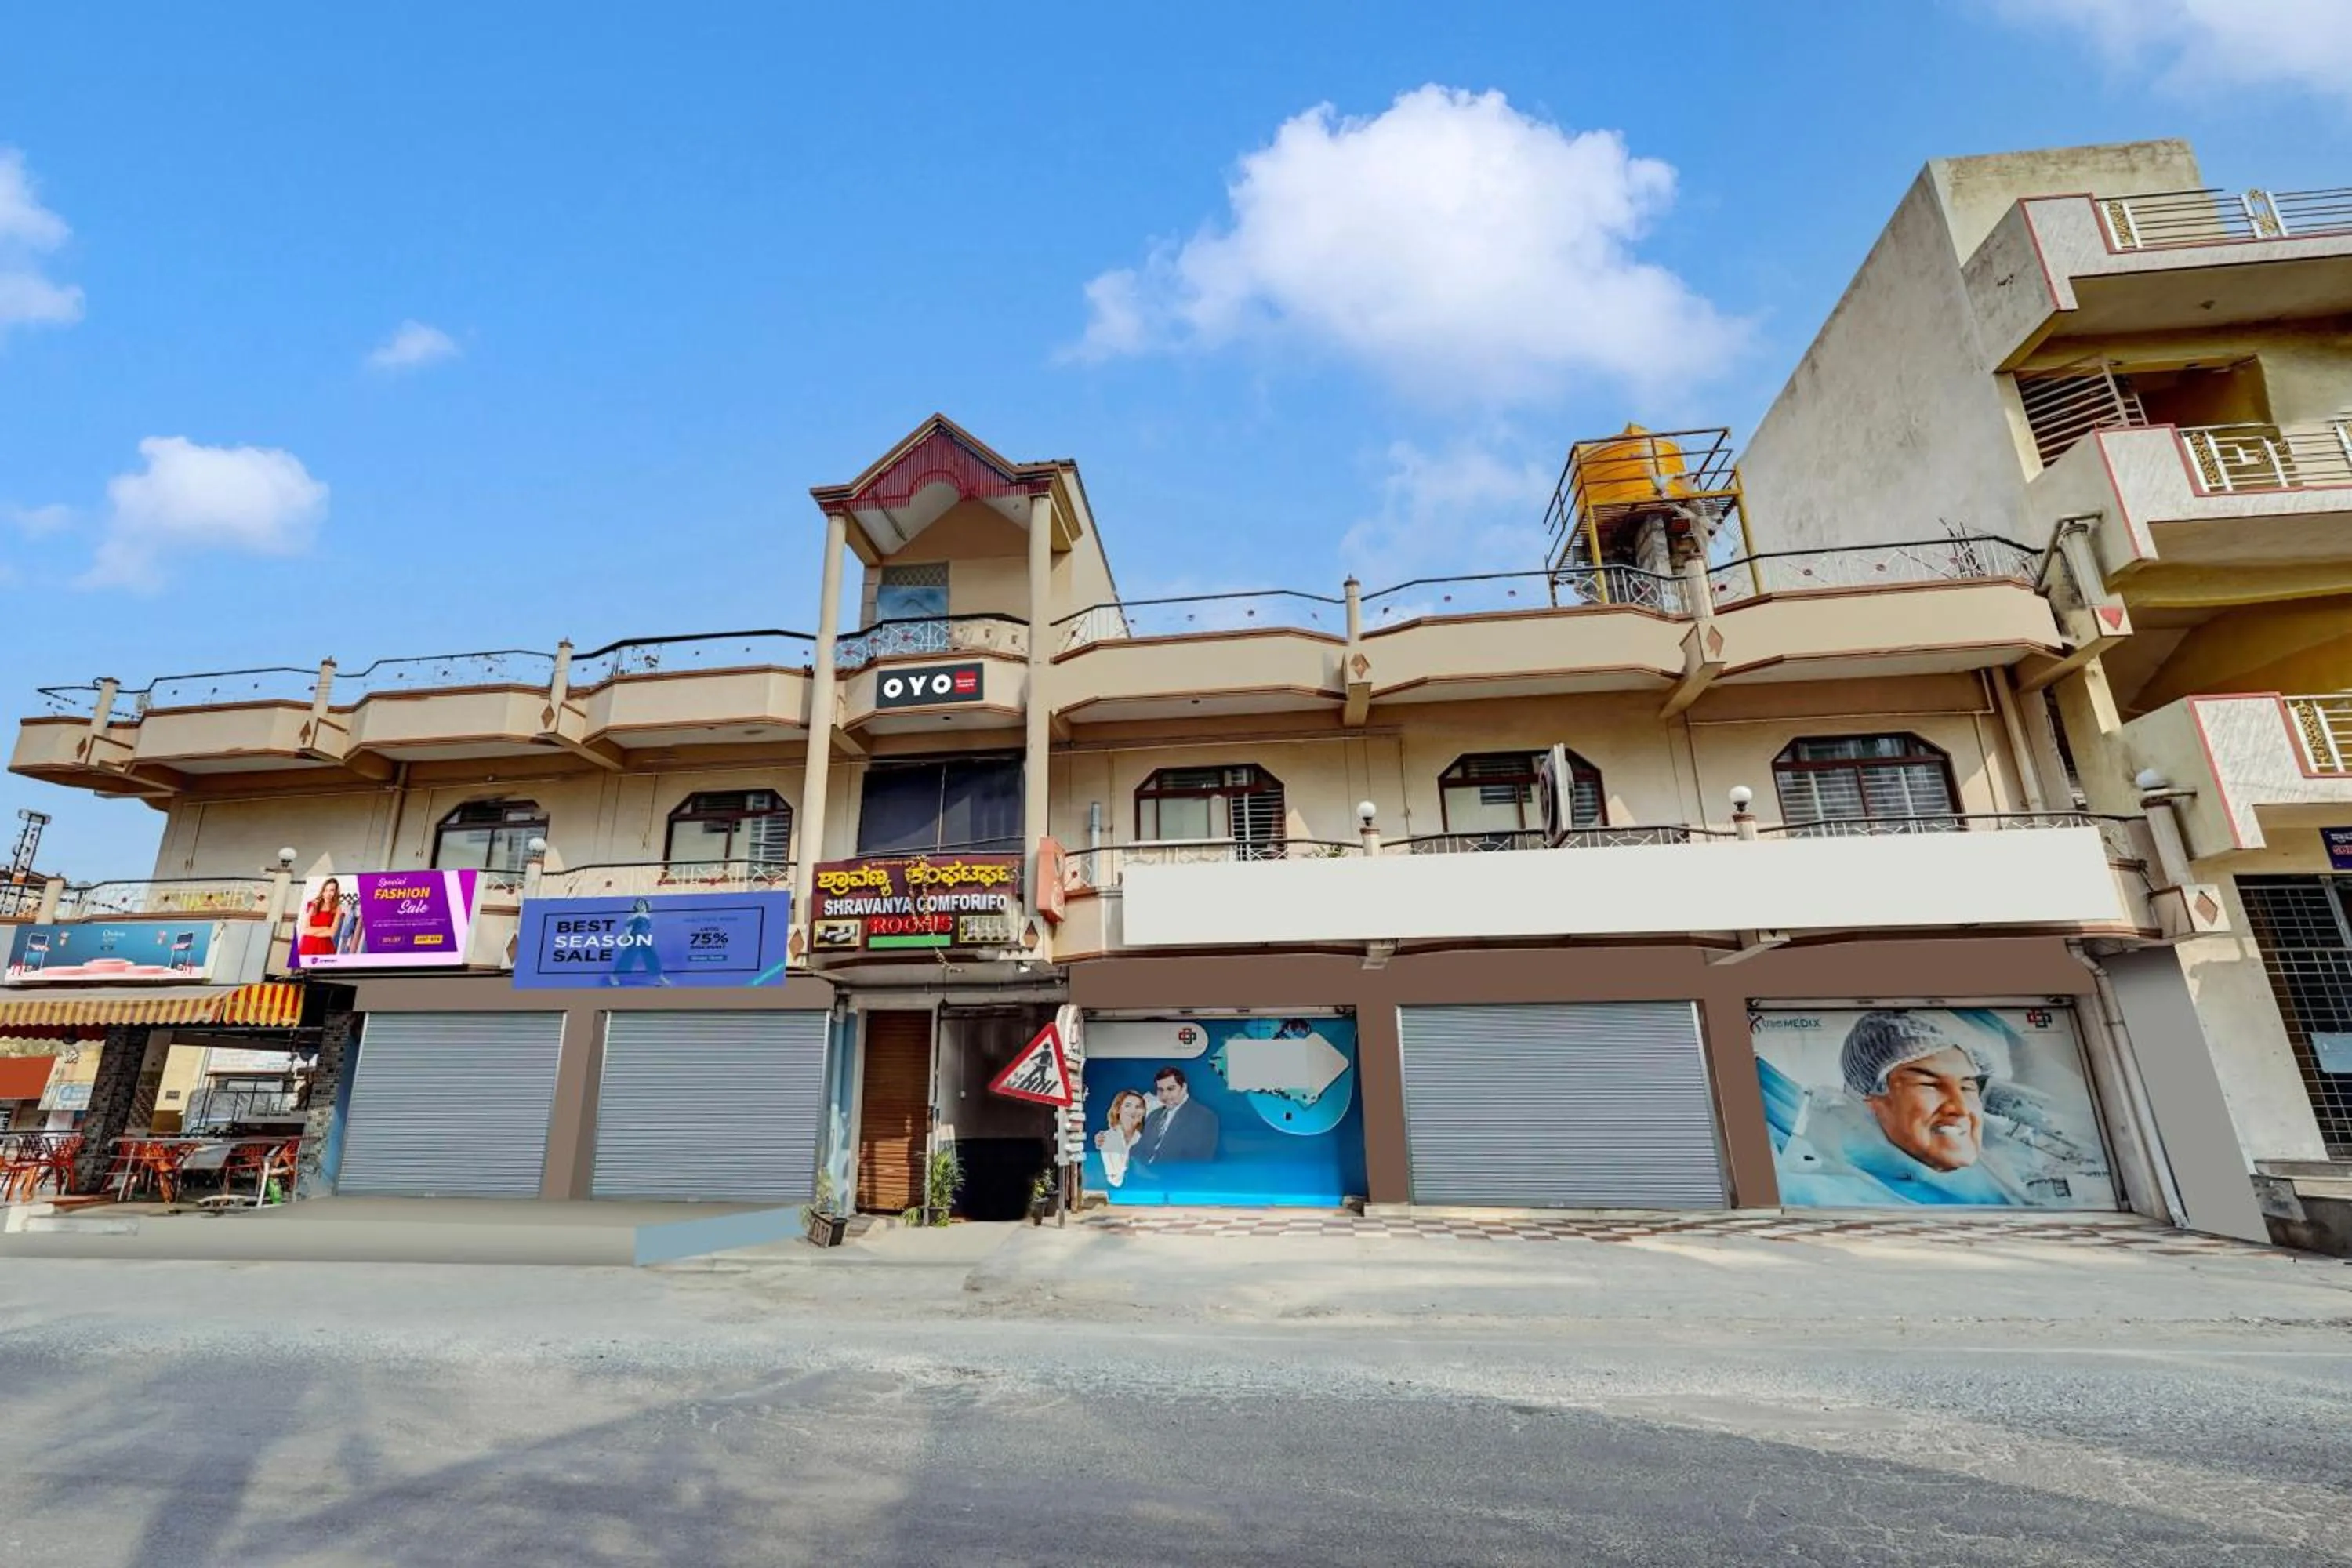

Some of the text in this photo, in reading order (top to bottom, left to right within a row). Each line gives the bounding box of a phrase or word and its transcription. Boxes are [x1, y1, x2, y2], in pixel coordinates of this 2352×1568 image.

[884, 673, 952, 698] OYO
[374, 887, 430, 899] FASHION
[397, 899, 429, 915] Sale
[824, 896, 913, 916] SHRAVANYA
[557, 920, 615, 933] BEST
[554, 934, 653, 948] SEASON
[690, 932, 728, 945] 75%
[553, 949, 613, 962] SALE
